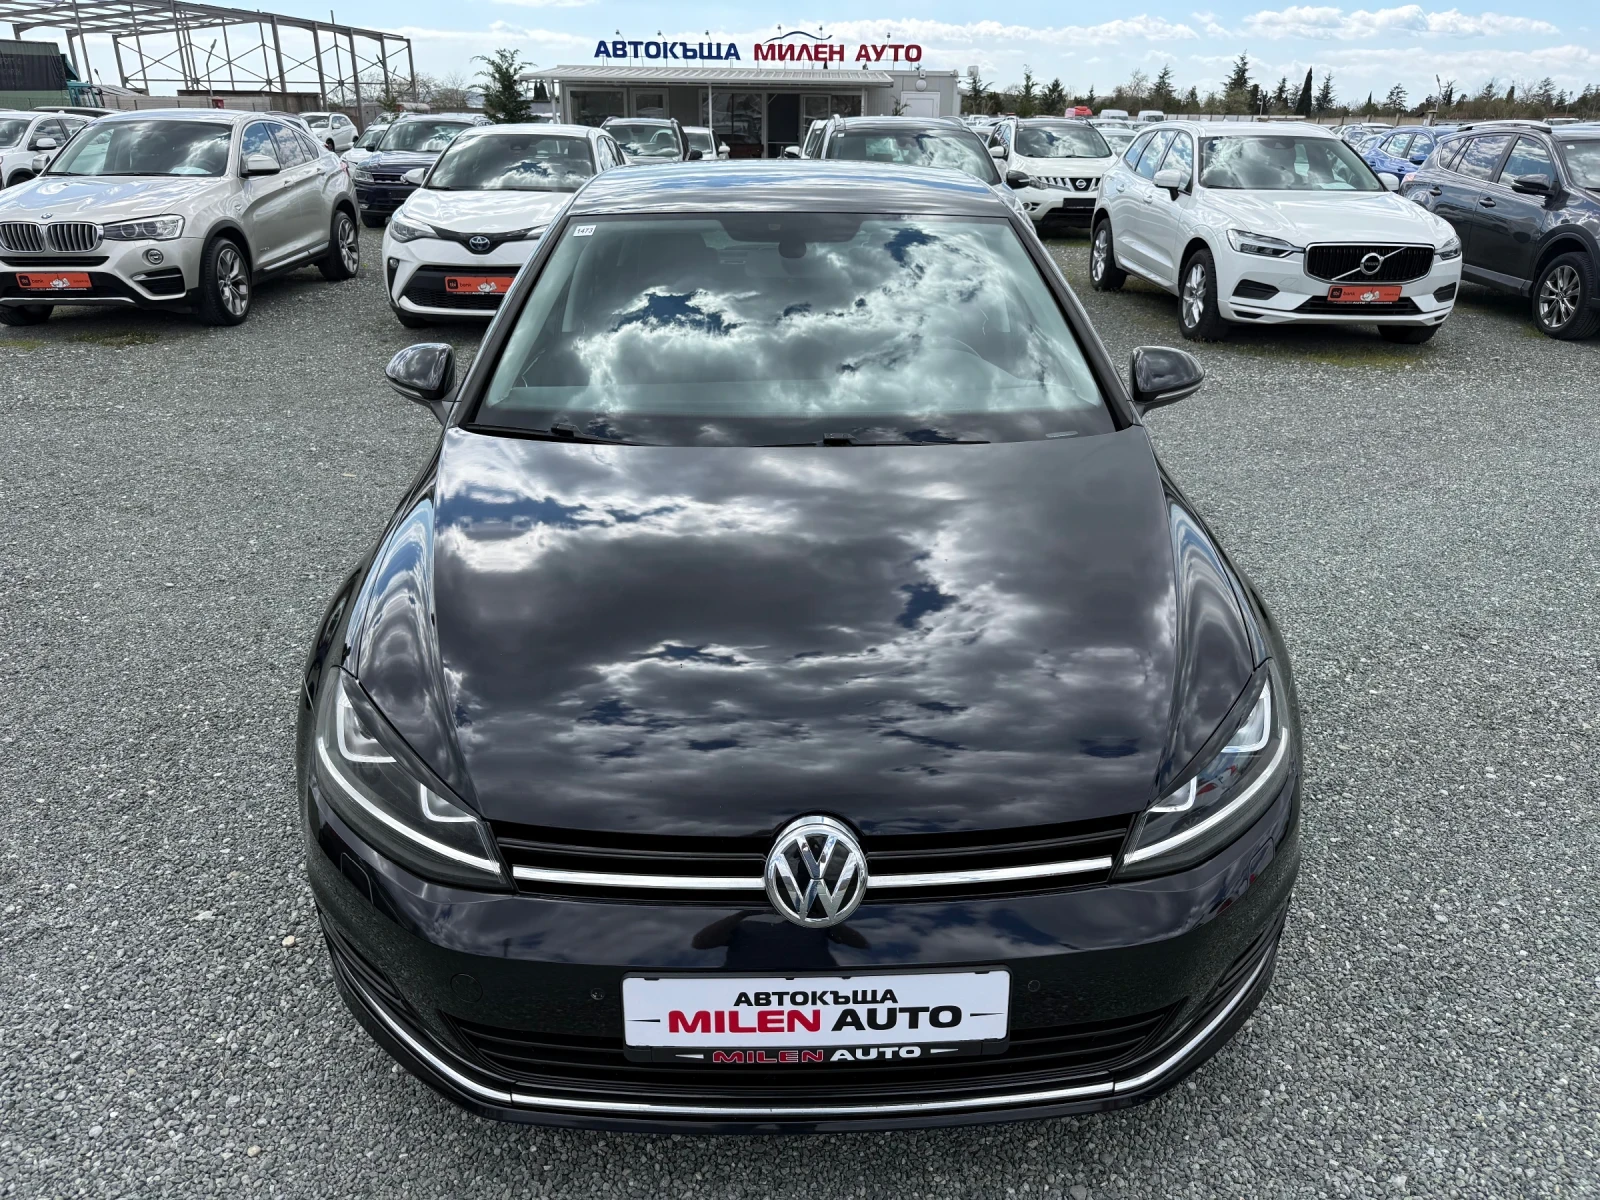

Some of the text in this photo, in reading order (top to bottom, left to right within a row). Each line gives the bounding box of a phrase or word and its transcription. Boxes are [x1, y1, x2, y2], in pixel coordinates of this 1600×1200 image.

[594, 40, 923, 62] АВТОКЪЩА МИЛЕН АУТО
[733, 989, 899, 1007] АВТОКЪЩА
[668, 1005, 962, 1033] MILEN AUTO
[712, 1046, 922, 1064] MILEN AUTO
